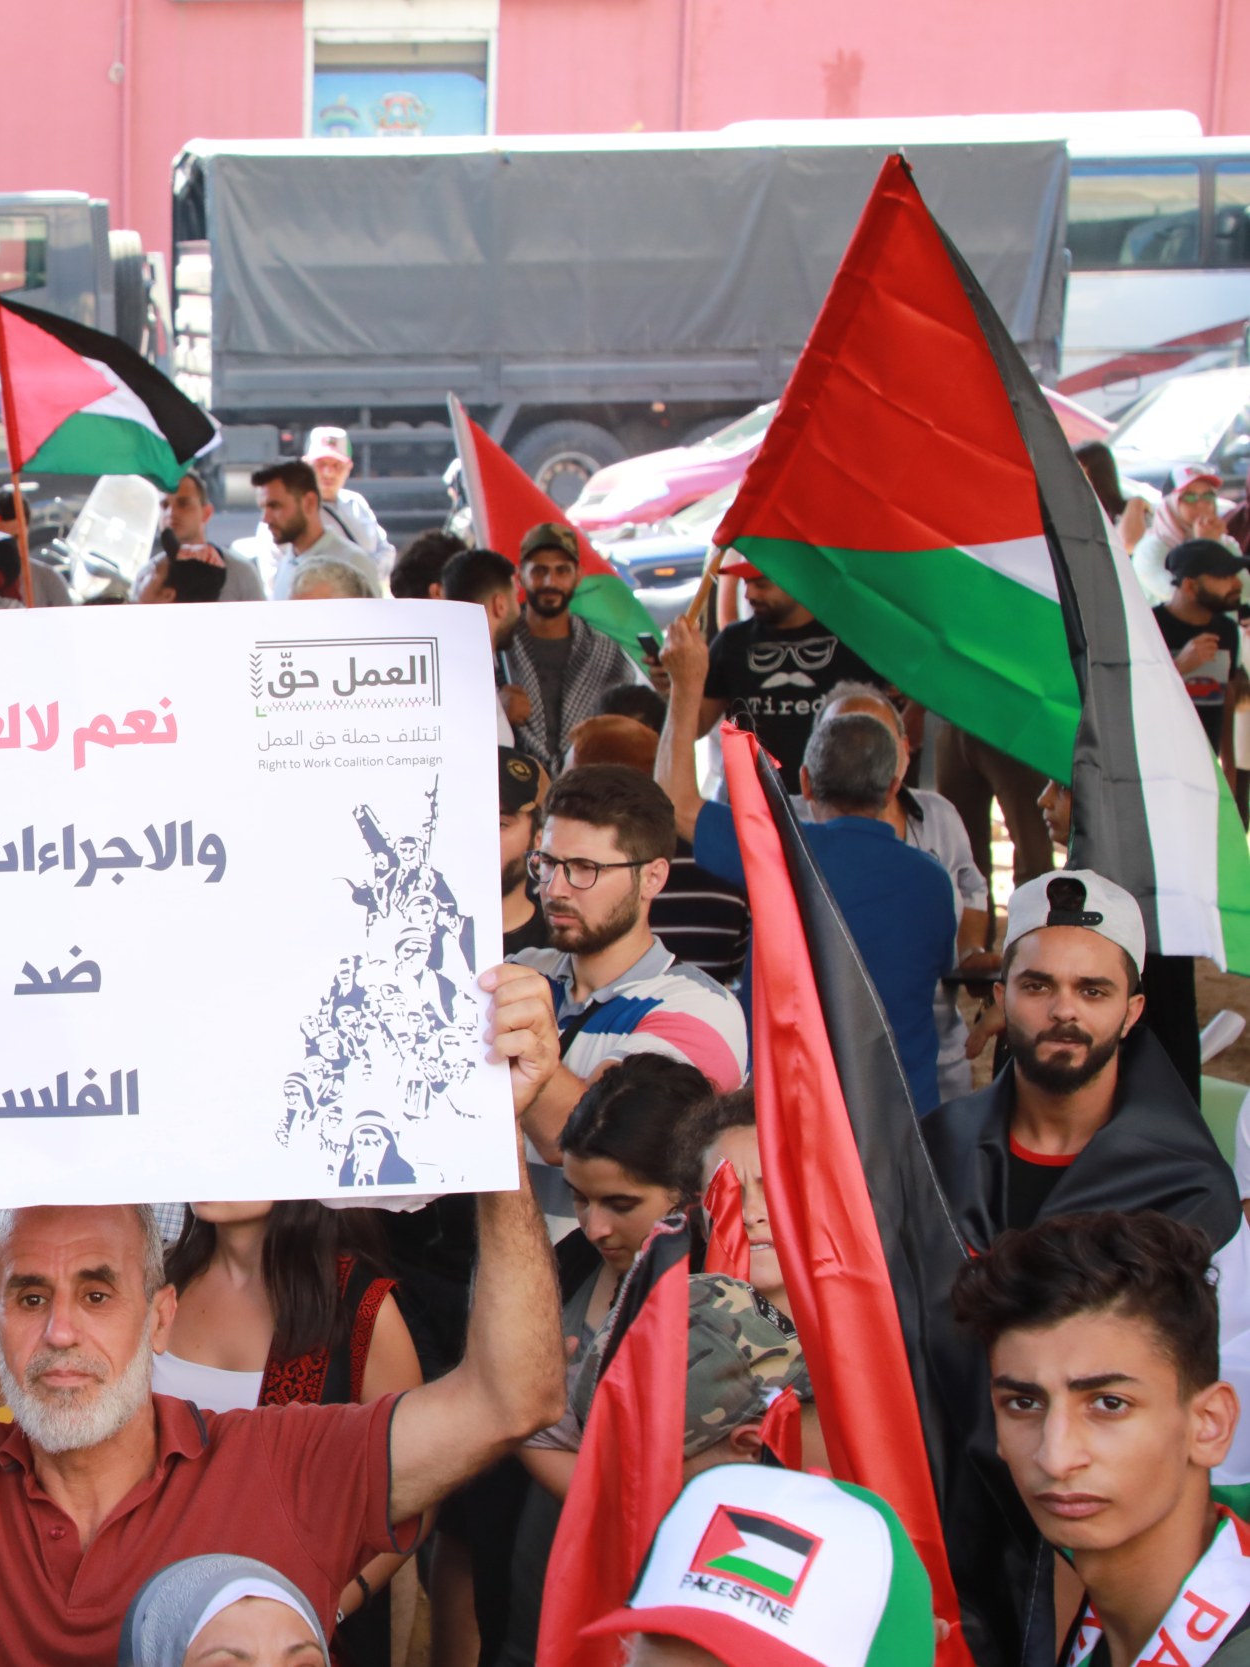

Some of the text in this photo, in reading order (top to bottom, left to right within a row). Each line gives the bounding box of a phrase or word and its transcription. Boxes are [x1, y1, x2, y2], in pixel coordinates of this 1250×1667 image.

[332, 654, 427, 697] العمل
[748, 694, 829, 716] Tired
[72, 696, 178, 771] نعم
[257, 725, 441, 752] ائتلاف حملة حق العمل
[258, 754, 443, 773] Right to Work Coalition Campaign
[13, 944, 102, 996] ضد
[679, 1573, 794, 1626] PALESTINE
